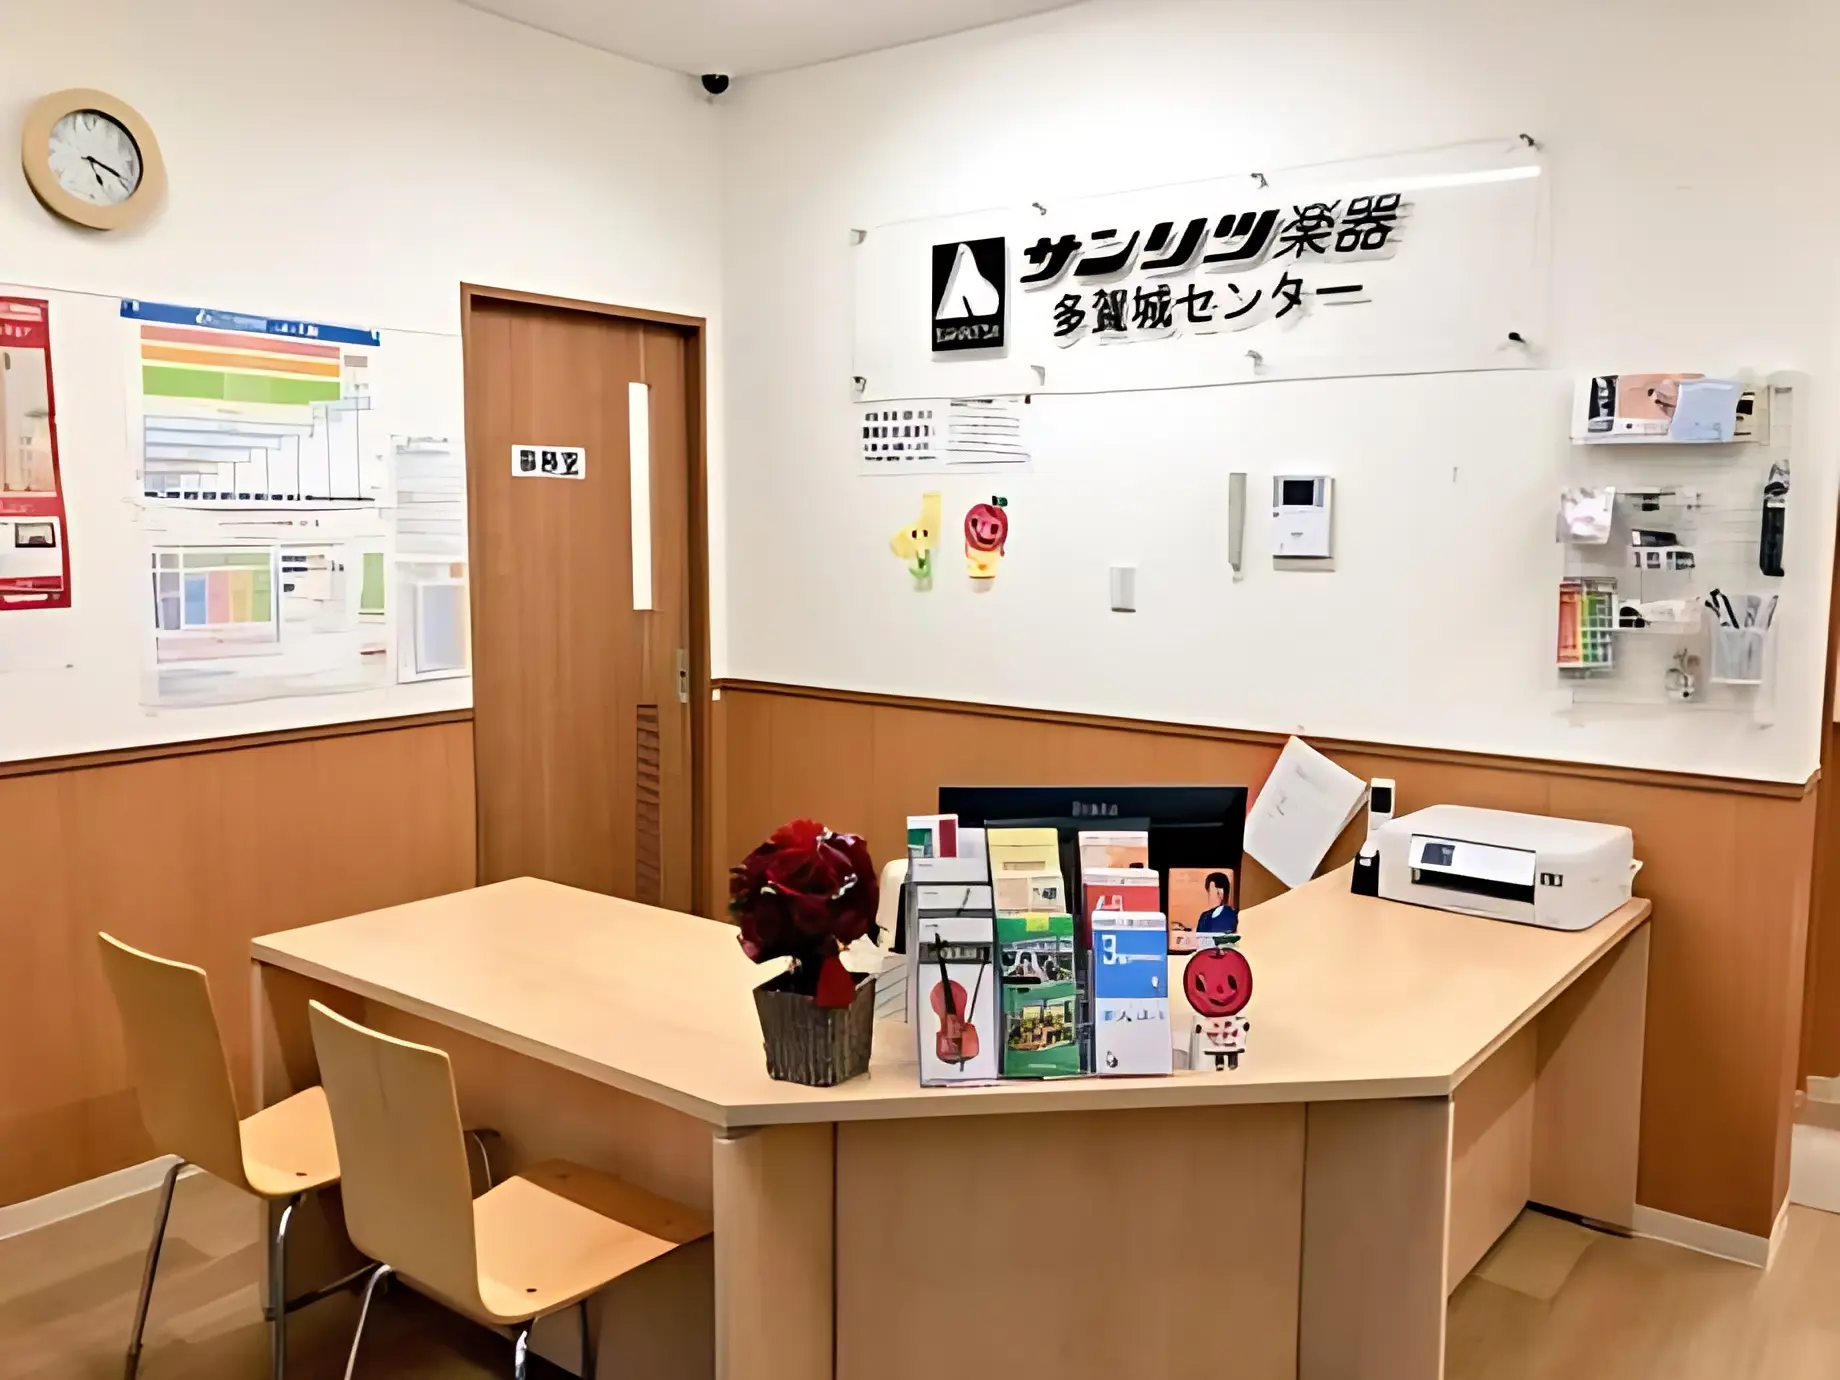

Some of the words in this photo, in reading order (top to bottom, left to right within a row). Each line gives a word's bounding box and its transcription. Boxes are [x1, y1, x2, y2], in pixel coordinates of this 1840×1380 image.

[1020, 193, 1402, 283] サンリツ楽器
